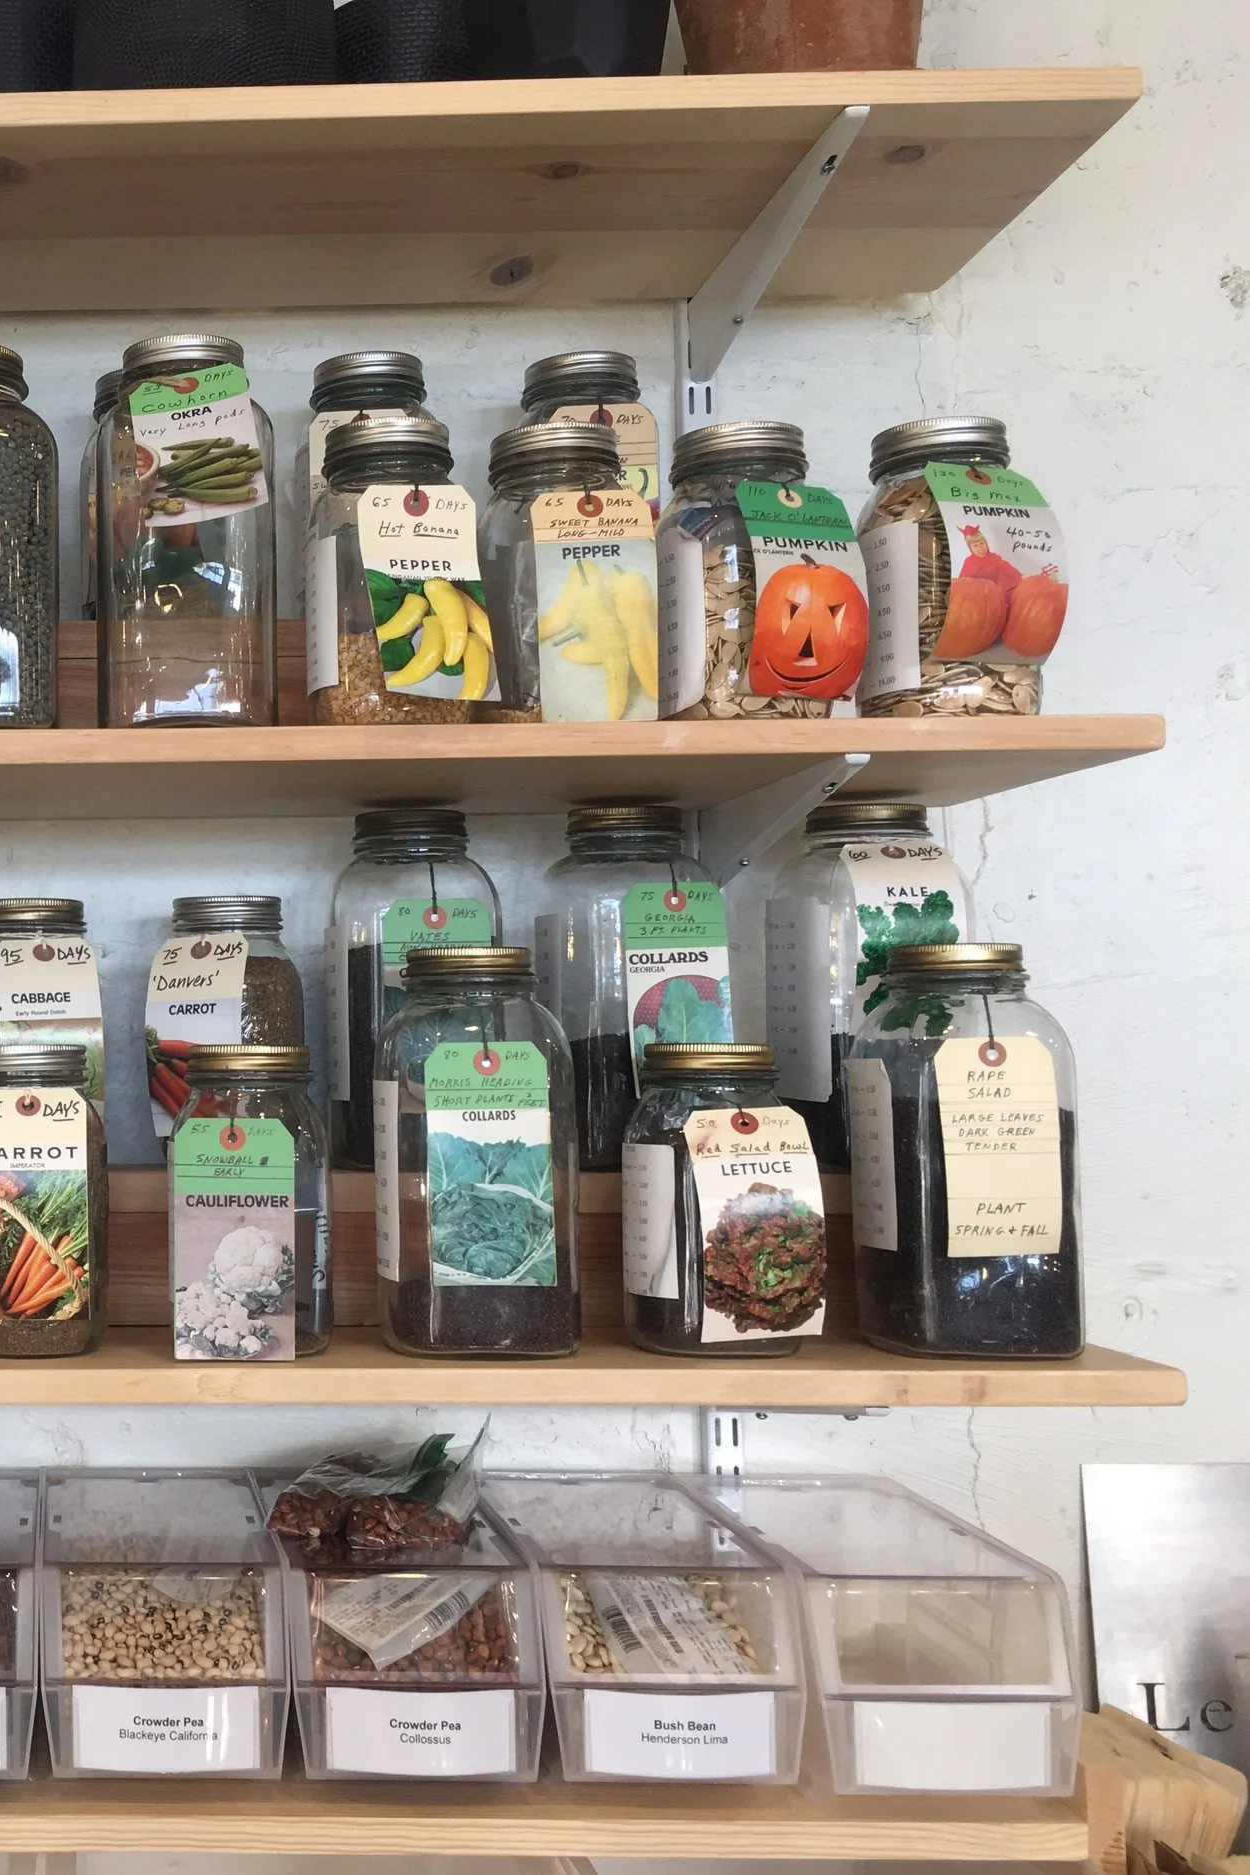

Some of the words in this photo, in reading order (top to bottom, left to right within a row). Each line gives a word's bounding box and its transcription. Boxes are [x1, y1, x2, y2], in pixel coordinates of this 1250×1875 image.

[141, 390, 228, 413] Cowhorn
[170, 405, 213, 421] OKRA
[616, 414, 644, 425] DAYS
[139, 427, 167, 437] Very
[178, 421, 206, 430] Long
[214, 408, 247, 425] pods
[318, 420, 339, 431] 75
[950, 485, 980, 501] Big
[372, 496, 392, 508] 65
[435, 498, 468, 513] DAYS
[545, 497, 564, 507] 65
[605, 497, 633, 508] DAYS
[751, 510, 782, 522] JACK
[963, 505, 1031, 519] PUMPKIN
[549, 518, 589, 528] SWEET
[597, 517, 639, 527] BANANA
[378, 520, 405, 538] Hot
[413, 521, 460, 540] Banana
[762, 535, 848, 552] PUMPKIN
[561, 544, 621, 560] PEPPER
[389, 558, 453, 572] PEPPER
[849, 850, 871, 862] 60
[907, 846, 943, 861] DAYS
[640, 891, 655, 901] 75
[687, 890, 714, 902] DAYS
[886, 886, 930, 898] KALE
[452, 907, 478, 919] DAYS
[644, 913, 696, 924] GEORGIA
[410, 930, 451, 942] VATES
[670, 925, 707, 935] PLANTS
[0, 948, 24, 967] 95
[57, 944, 91, 965] DAYS
[162, 947, 183, 965] 75
[213, 941, 244, 961] DAYS
[629, 951, 709, 965] COLLARDS
[629, 965, 665, 974] GEORGIA
[11, 992, 72, 1005] CABBAGE
[168, 1003, 217, 1016] CARROT
[504, 1050, 531, 1061] DAYS
[428, 1077, 472, 1088] MORRIS
[480, 1076, 532, 1088] HEADING
[967, 1070, 1007, 1083] RAPE
[967, 1087, 1012, 1100] SALAD
[433, 1094, 471, 1108] SHORT
[474, 1093, 515, 1105] PLANTS
[42, 1099, 80, 1121] DAYS
[461, 1109, 517, 1122] COLLARDS
[951, 1113, 993, 1124] LARGE
[1000, 1113, 1045, 1123] LEAVES
[247, 1126, 273, 1136] DAYS
[958, 1128, 990, 1138] DARK
[997, 1127, 1036, 1137] GREEN
[695, 1142, 722, 1158] Red
[729, 1140, 771, 1156] Salad
[965, 1141, 1018, 1152] TENDER
[195, 1153, 254, 1167] SNOWBALL
[213, 1167, 245, 1179] EARLY
[721, 1161, 793, 1176] LETTUCE
[185, 1194, 289, 1208] CAULIFLOWER
[976, 1201, 1027, 1216] PLANT
[954, 1224, 1005, 1237] SPRING
[1020, 1224, 1049, 1237] FALL
[133, 1716, 181, 1727] Crowder
[183, 1717, 204, 1727] Pea
[389, 1718, 438, 1731] Crowder
[441, 1720, 461, 1731] Pea
[654, 1720, 684, 1731] Bush
[687, 1721, 717, 1731] Bean
[118, 1729, 166, 1743] Blackeye
[169, 1730, 218, 1741] Californa
[399, 1733, 452, 1745] Collossus
[641, 1733, 700, 1745] Henderson
[703, 1735, 729, 1745] Lima
